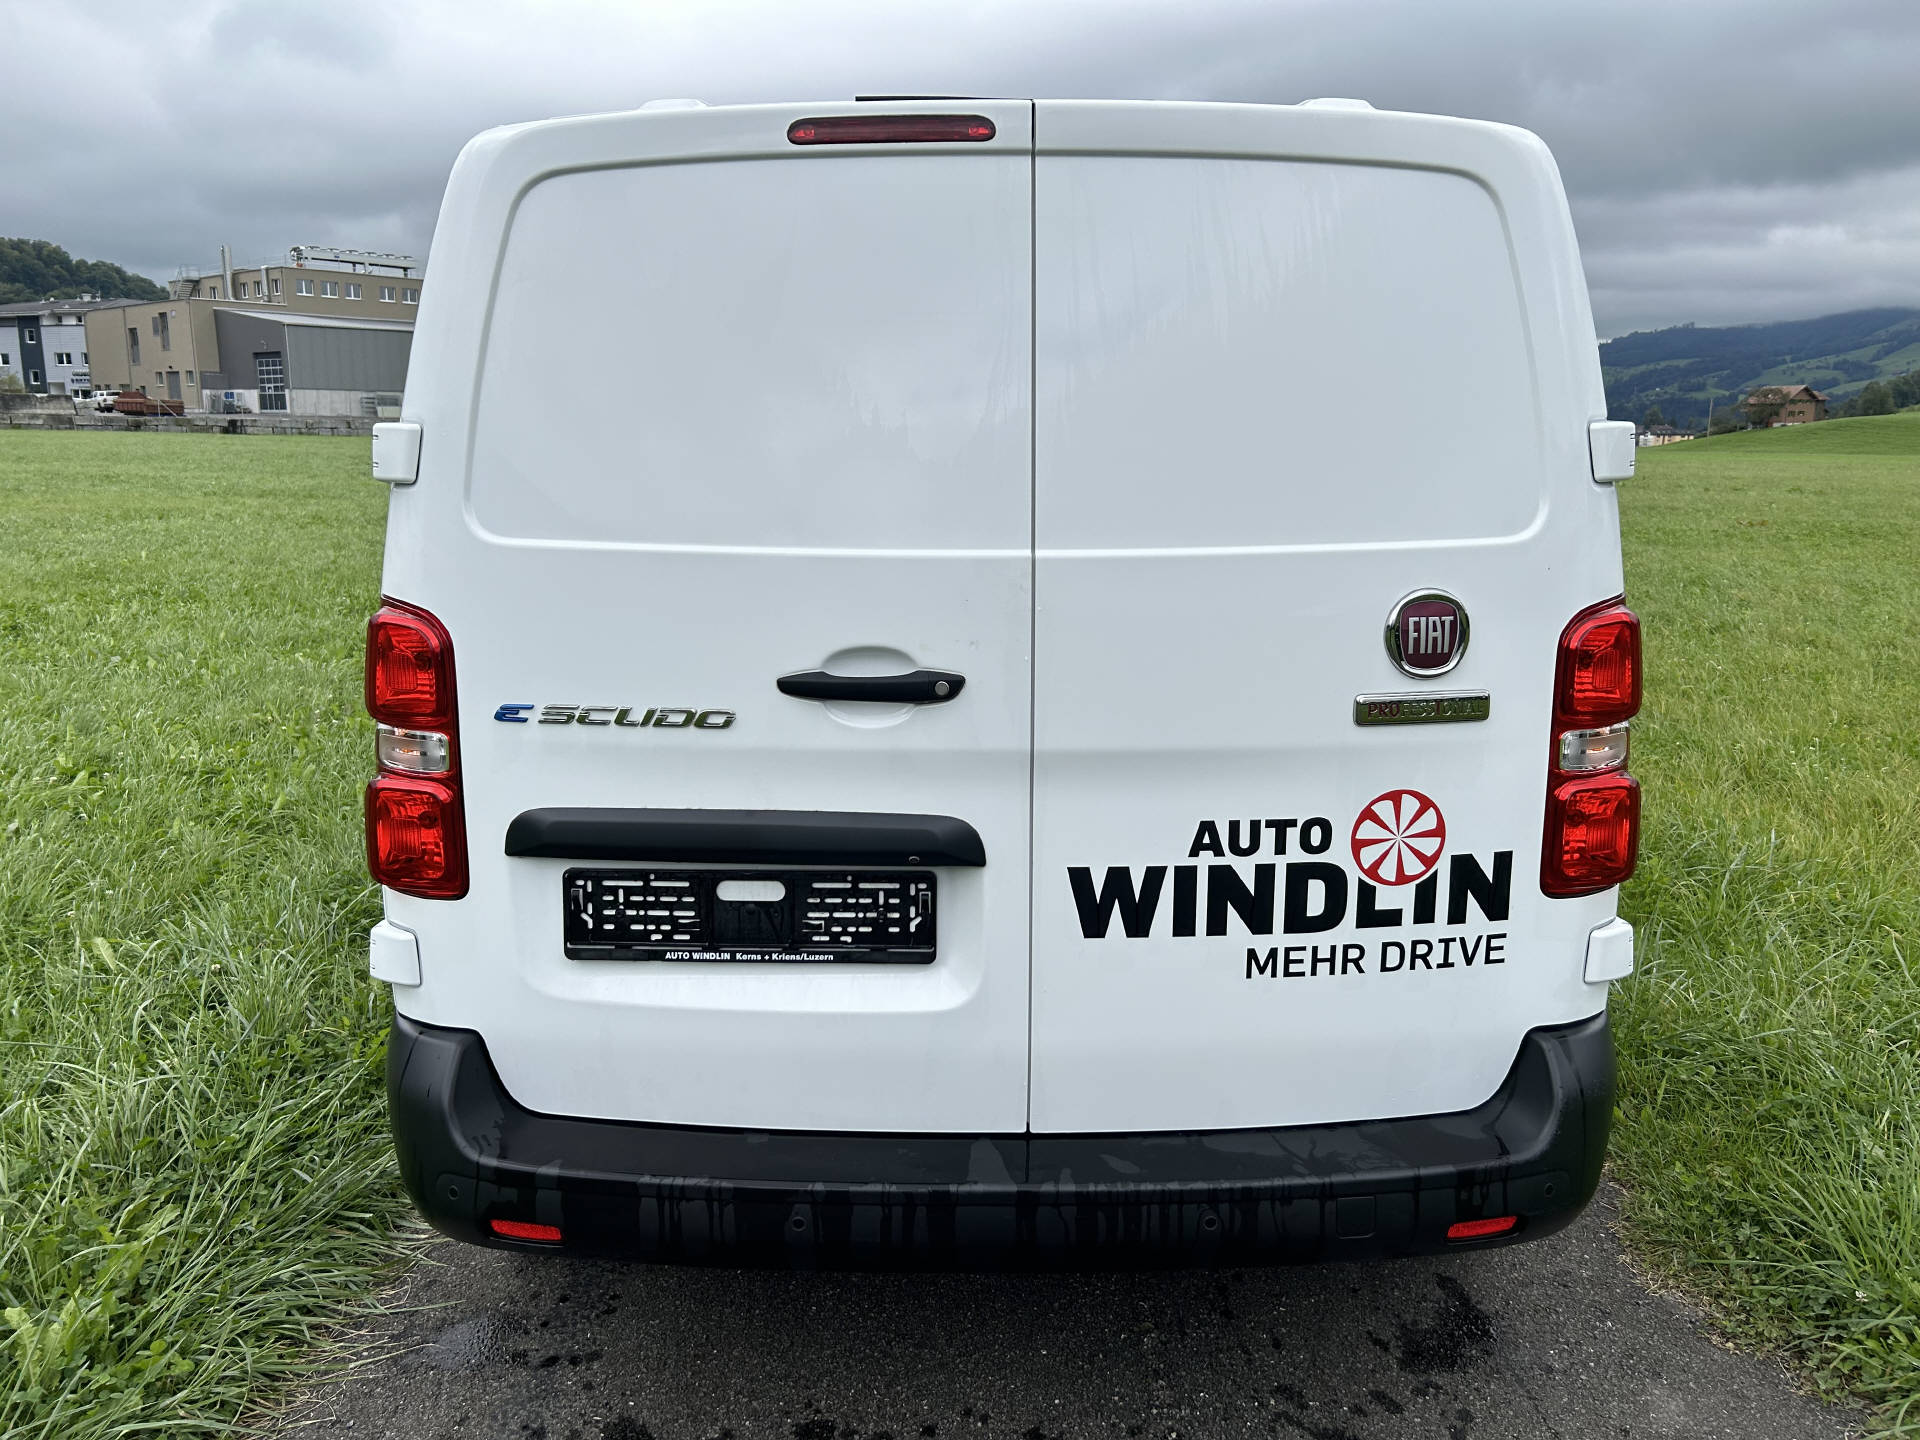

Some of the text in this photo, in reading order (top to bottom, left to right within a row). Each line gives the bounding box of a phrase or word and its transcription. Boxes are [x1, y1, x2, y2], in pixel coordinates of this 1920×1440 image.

[1408, 615, 1454, 655] FIAT
[1188, 816, 1333, 858] AUTO
[1066, 850, 1514, 938] WINDLIN
[665, 952, 690, 960] AUTO
[692, 952, 731, 961] WINDLIN
[735, 952, 762, 961] Kerns
[771, 952, 834, 961] Kriens/Luzern
[1245, 932, 1508, 979] MEHR DRIVE
